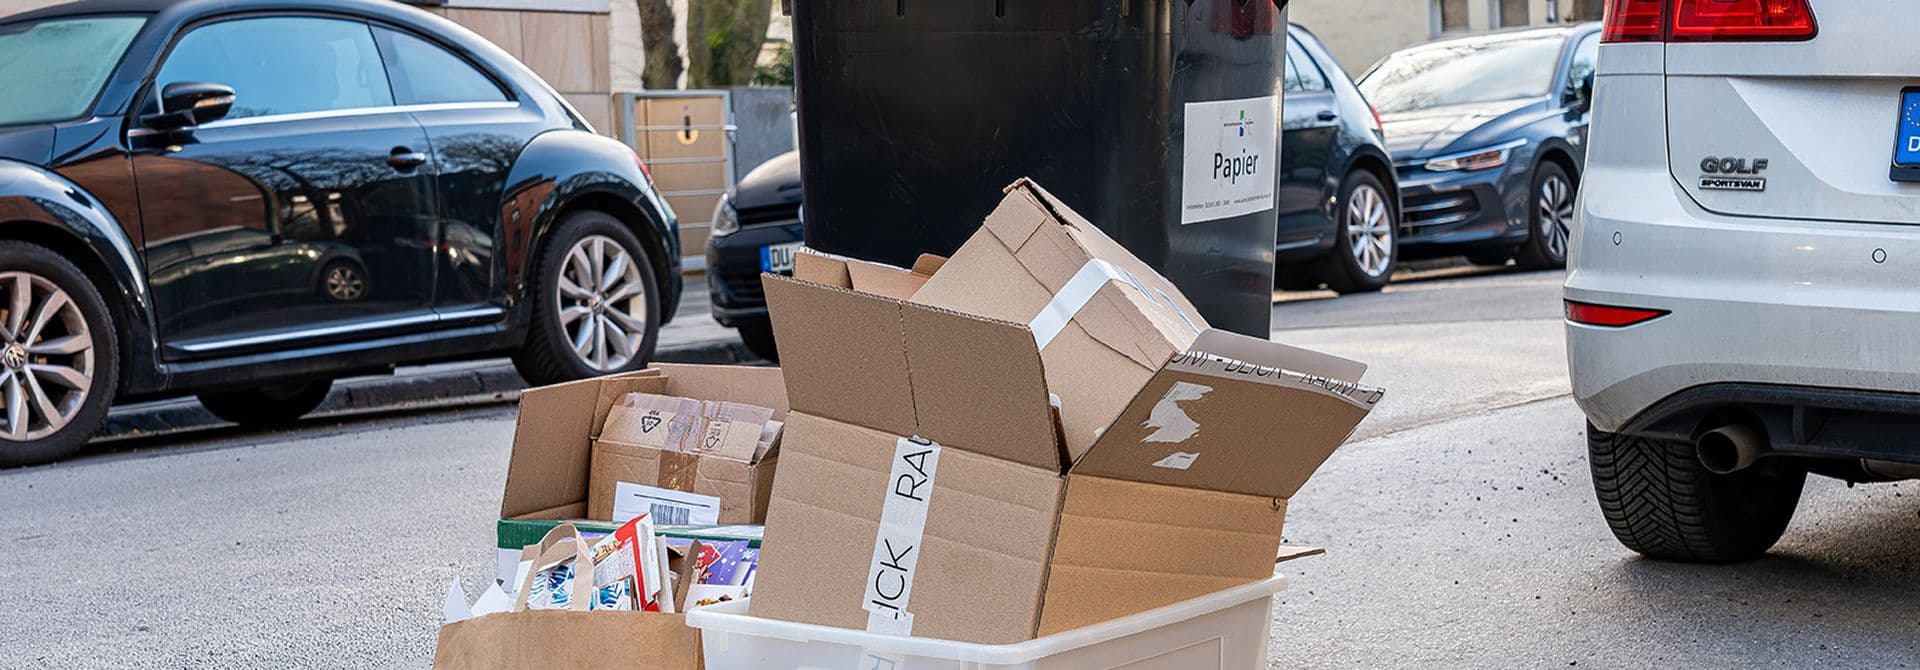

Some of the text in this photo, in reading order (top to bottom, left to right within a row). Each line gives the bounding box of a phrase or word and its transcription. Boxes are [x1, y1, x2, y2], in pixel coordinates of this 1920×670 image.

[1213, 148, 1259, 185] Papier
[1700, 156, 1769, 174] GOLF
[1700, 179, 1761, 188] SPORTSVAN
[771, 247, 790, 268] DU
[872, 538, 914, 620] ICK
